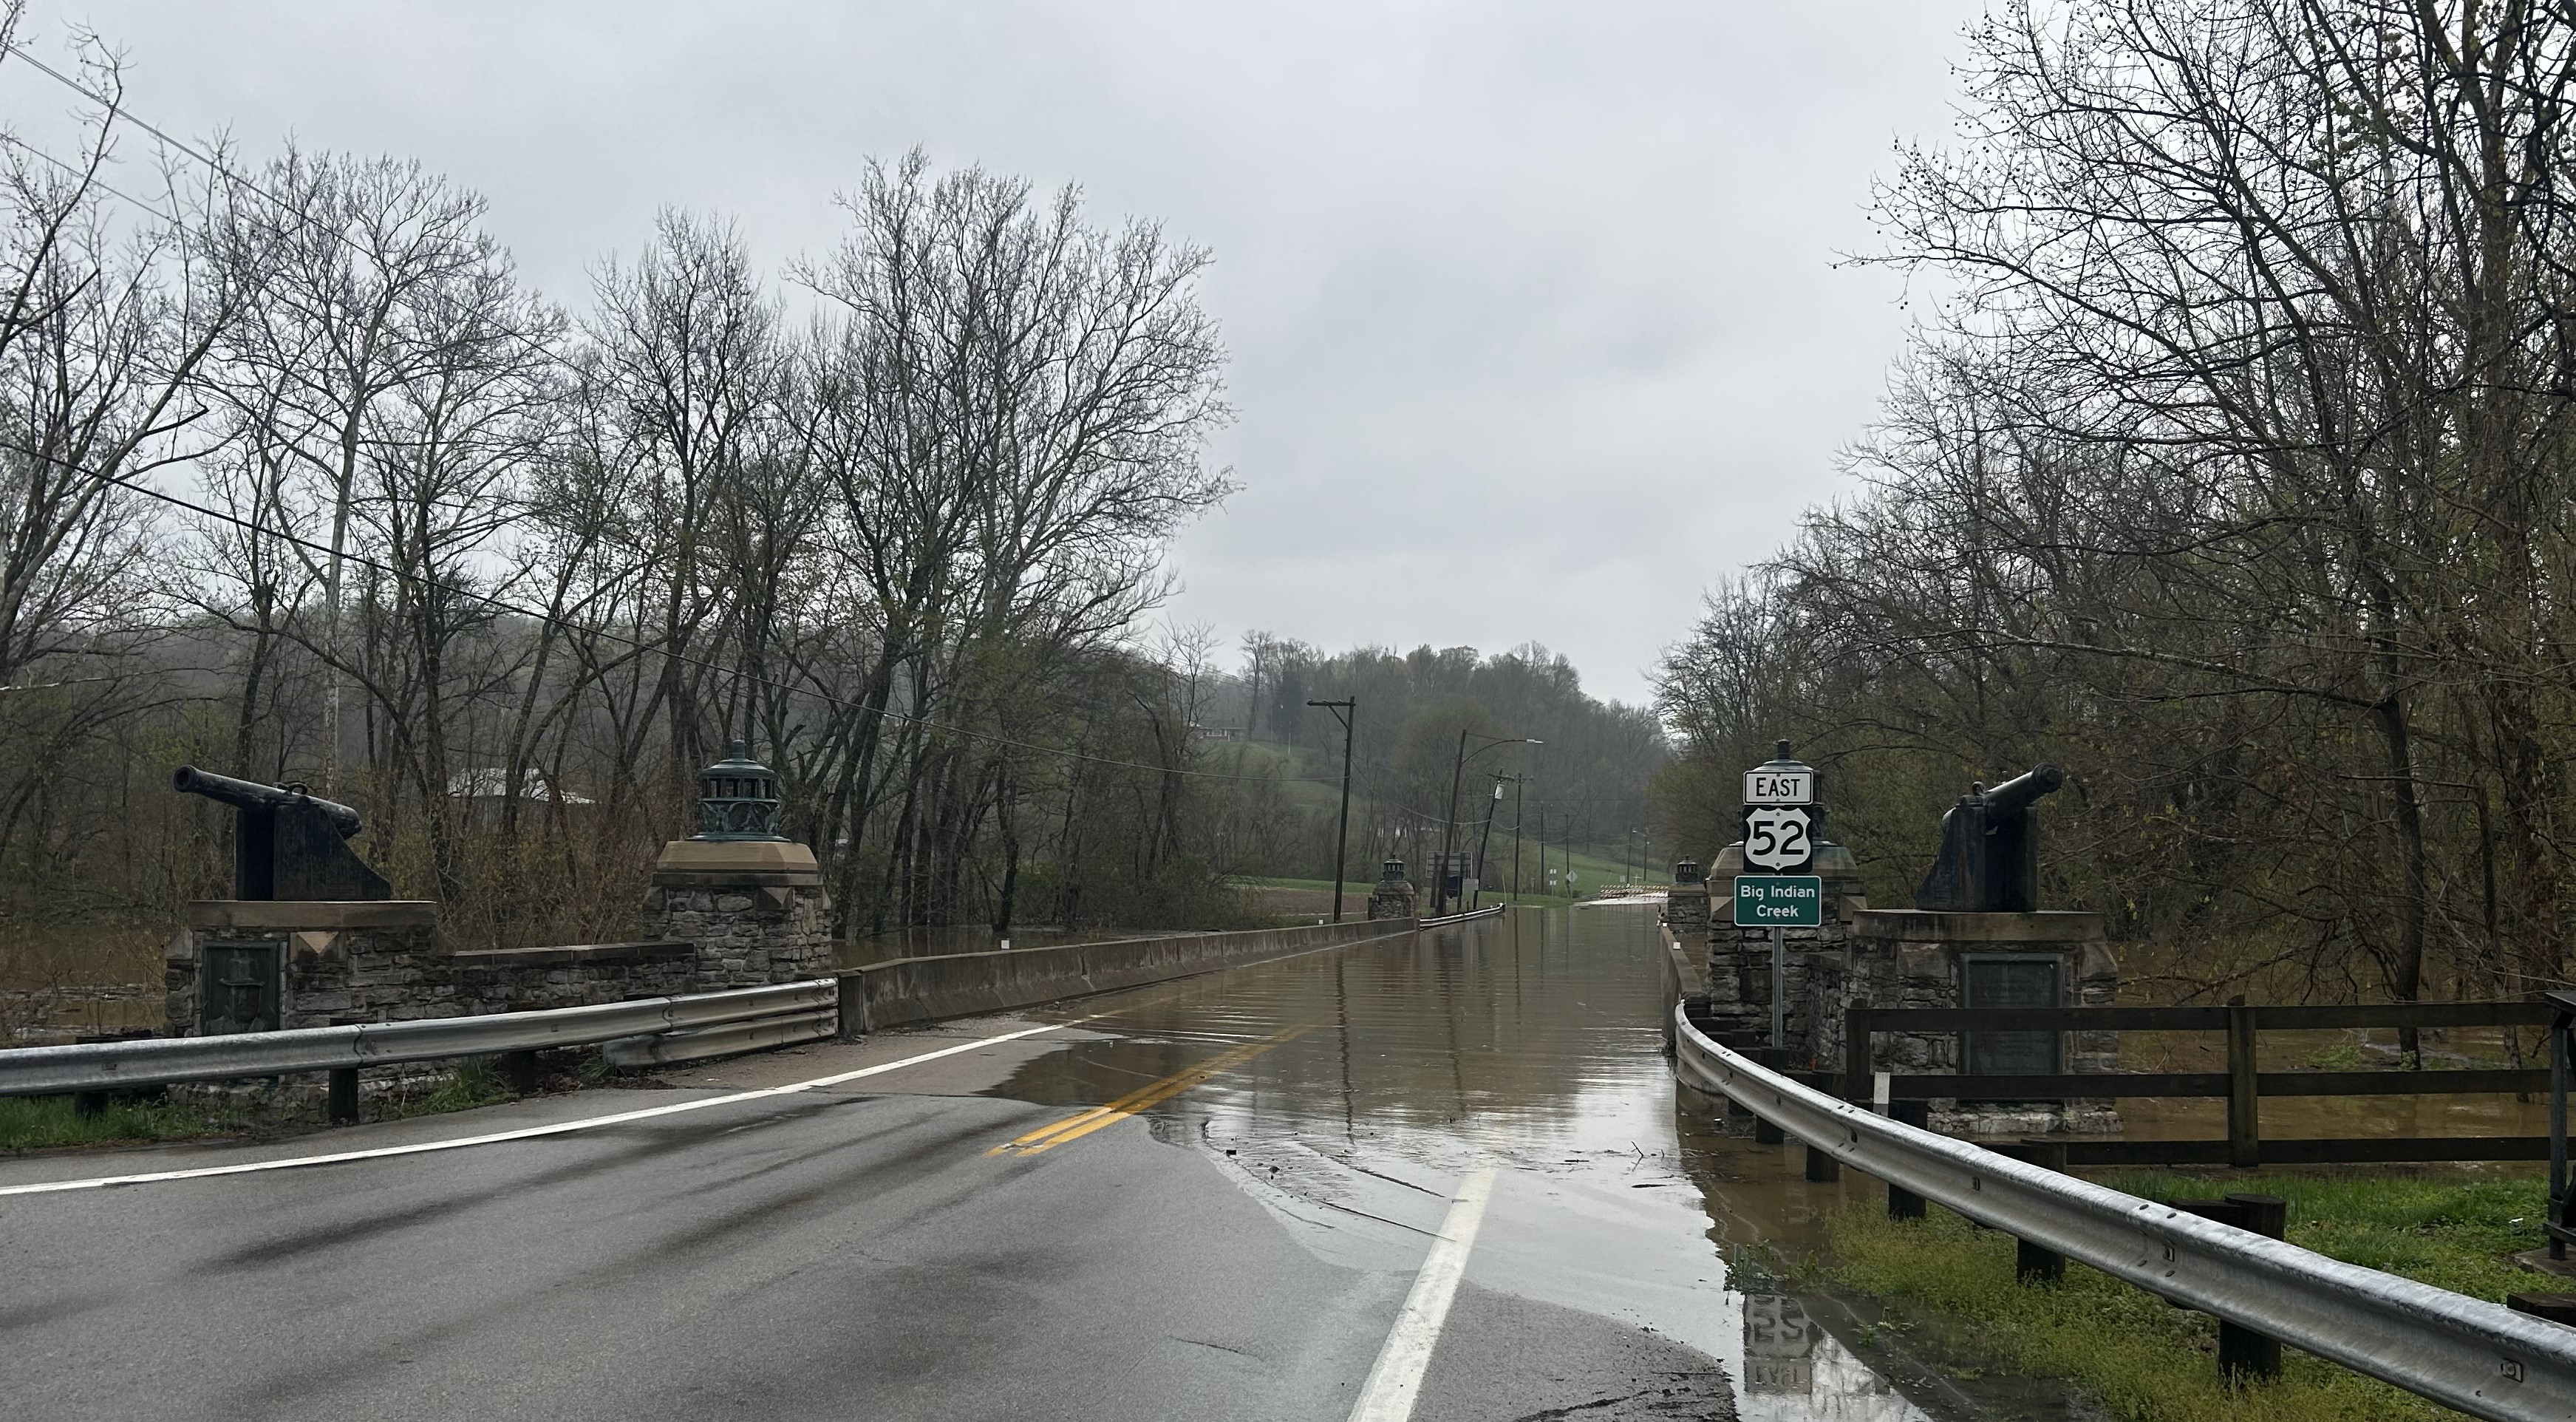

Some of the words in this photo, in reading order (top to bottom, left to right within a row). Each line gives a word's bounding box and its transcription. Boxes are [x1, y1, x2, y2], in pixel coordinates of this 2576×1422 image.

[1756, 777, 1801, 797] EAST
[1752, 820, 1804, 856] 52
[1740, 885, 1765, 901] Big
[1771, 885, 1816, 898] Indian
[1756, 904, 1799, 917] Creek
